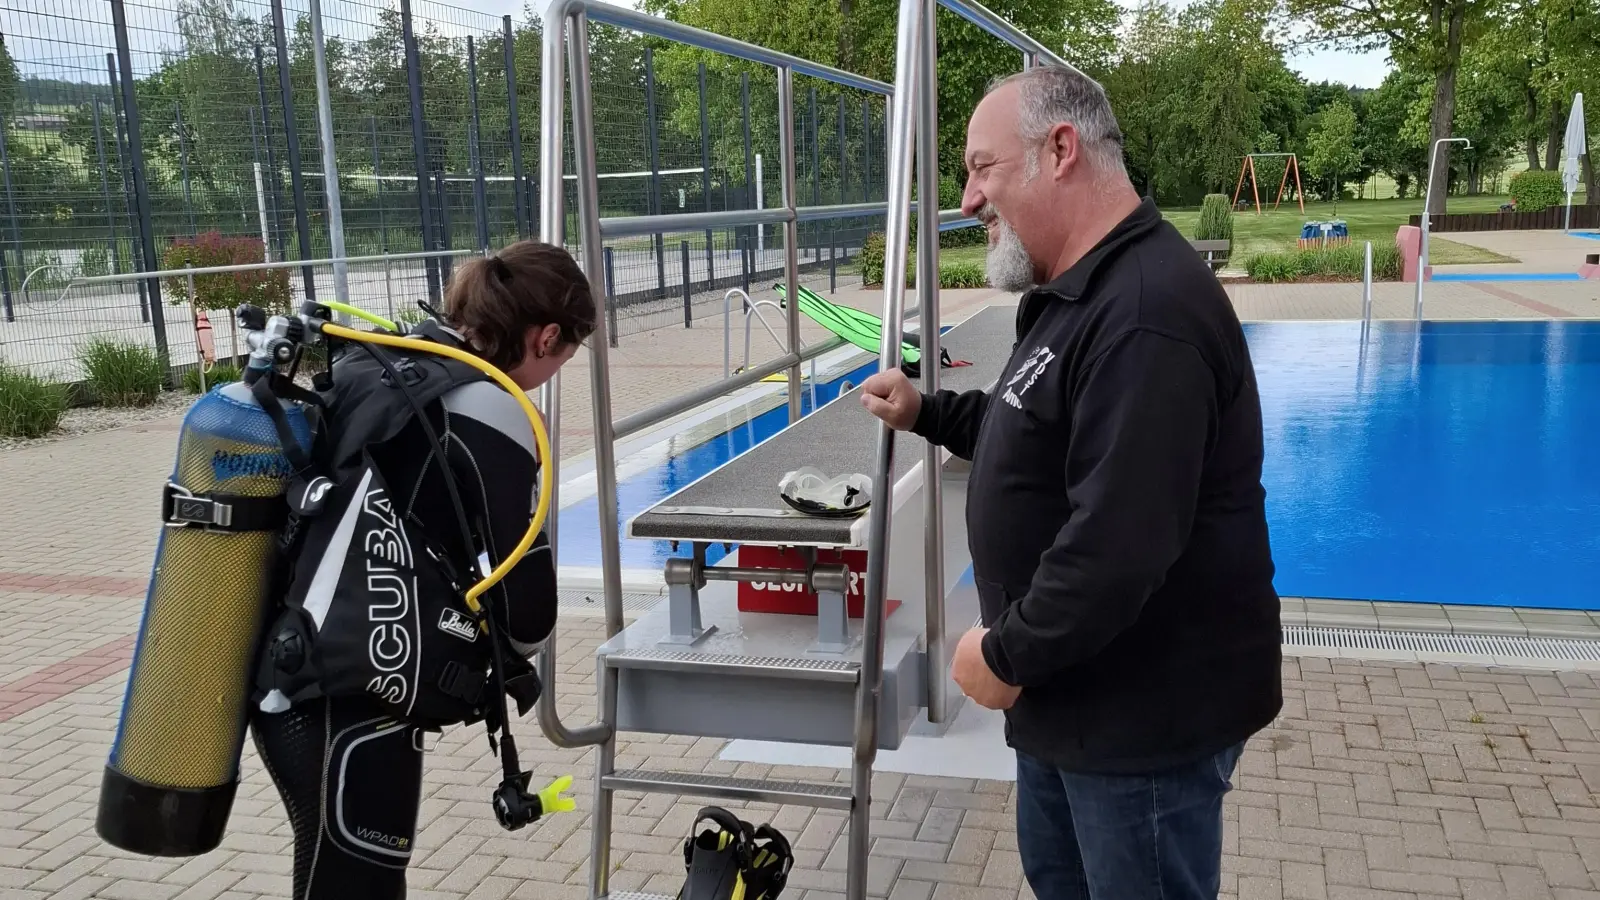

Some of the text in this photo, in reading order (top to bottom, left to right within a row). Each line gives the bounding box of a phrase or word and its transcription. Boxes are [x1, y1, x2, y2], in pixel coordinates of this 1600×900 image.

[1020, 352, 1056, 396] VDST
[363, 488, 411, 704] SCUBA
[441, 611, 476, 639] Bella
